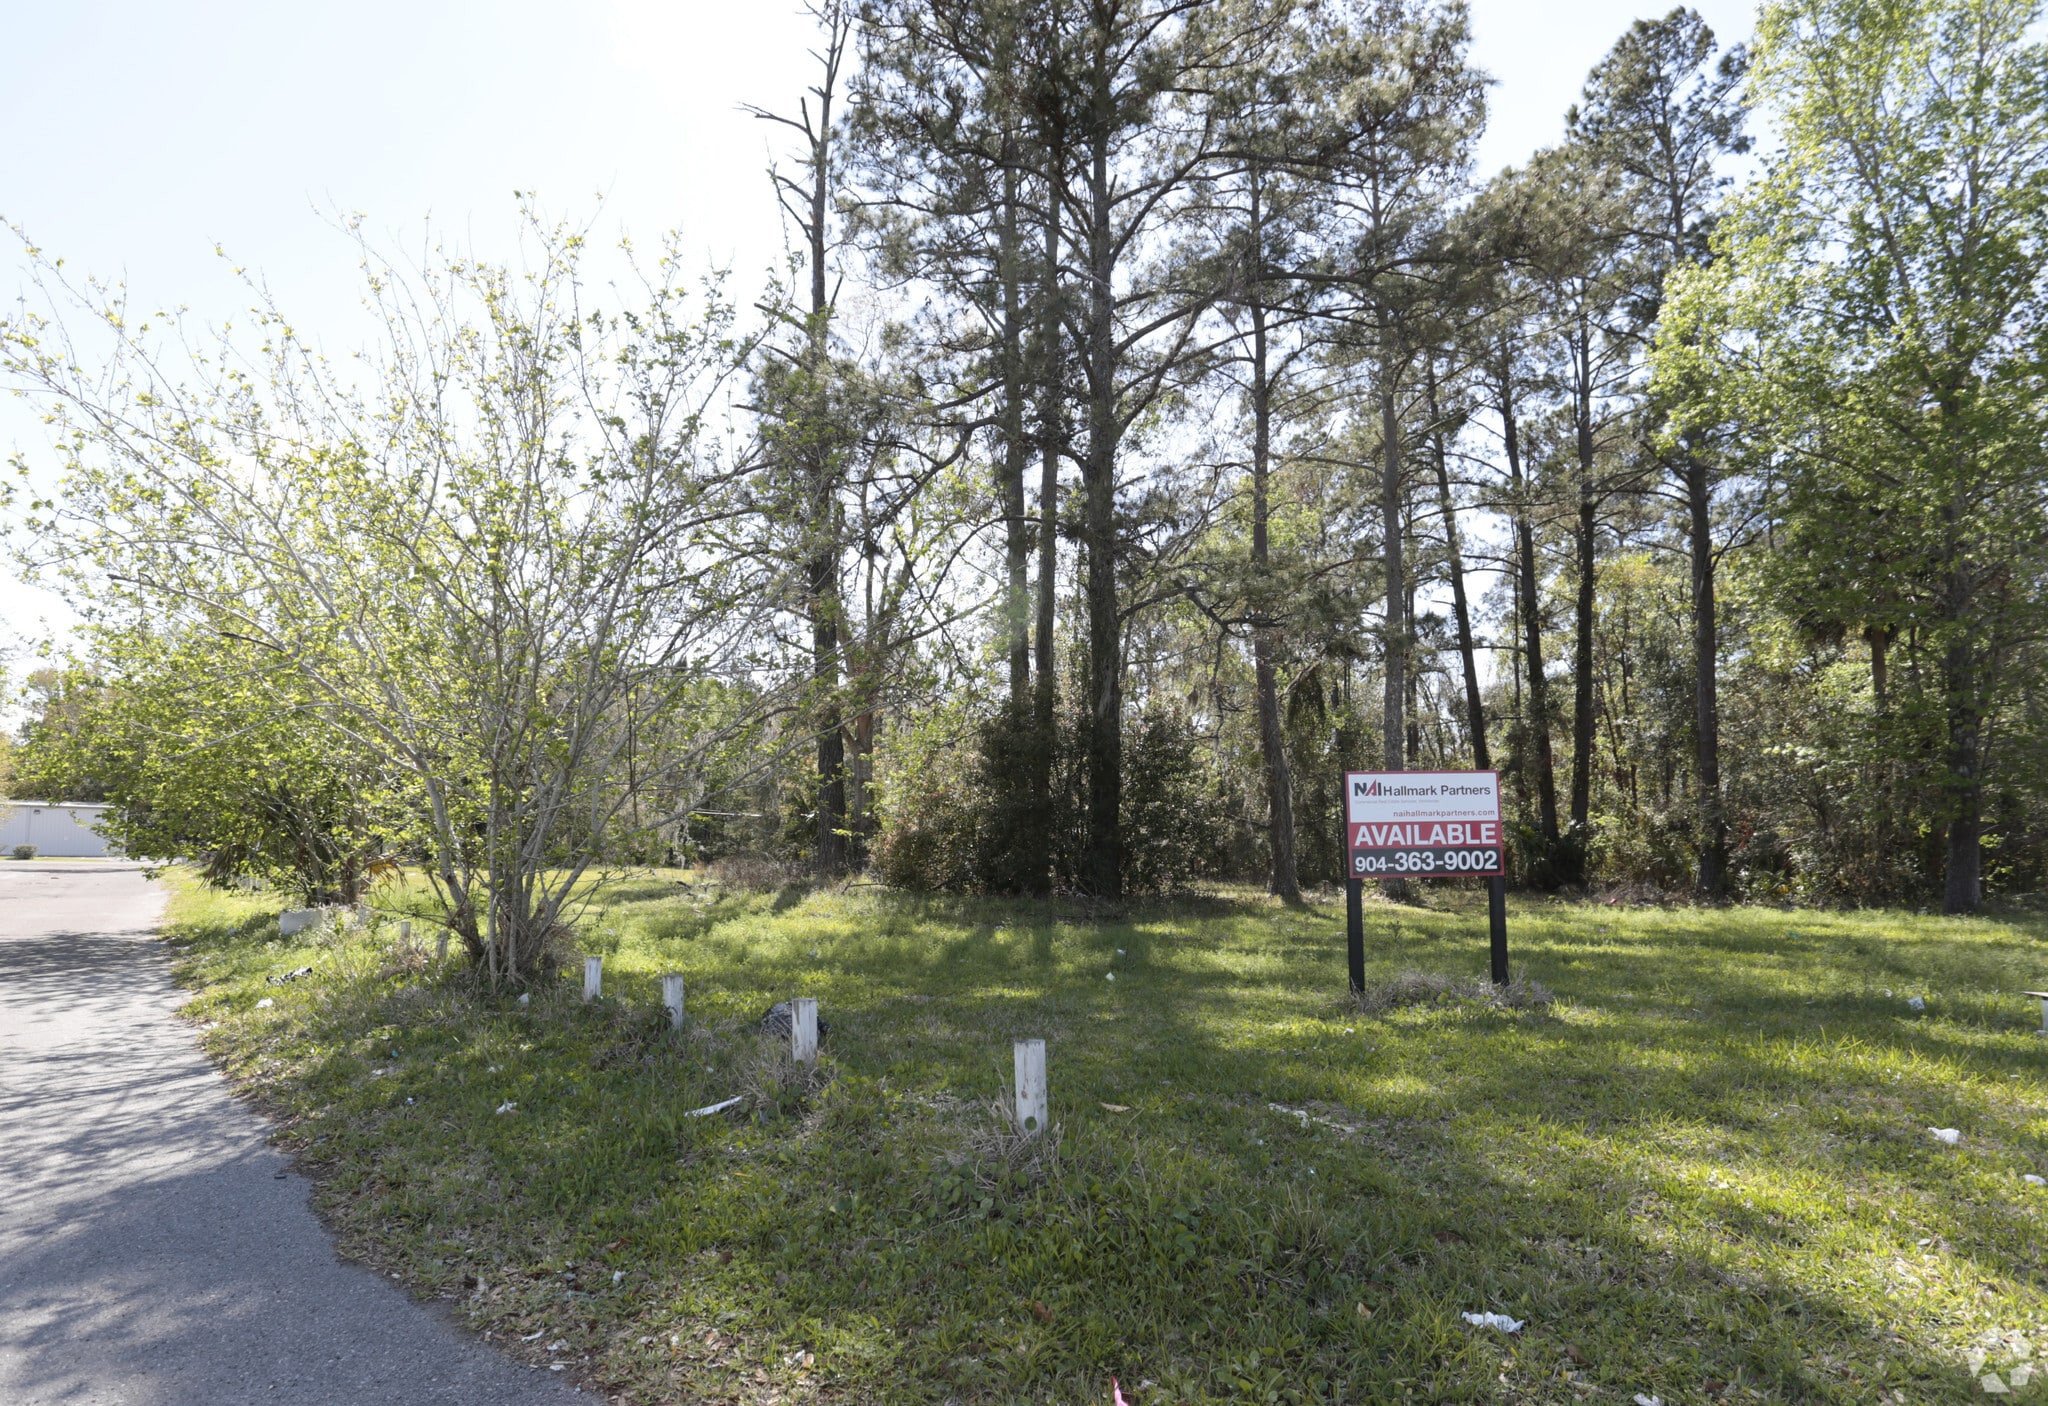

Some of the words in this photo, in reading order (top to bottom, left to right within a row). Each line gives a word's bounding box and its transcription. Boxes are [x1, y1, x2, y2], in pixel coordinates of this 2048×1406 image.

[1441, 785, 1491, 796] Partners
[1393, 809, 1496, 818] naihallmarkpartners.com
[1354, 823, 1497, 847] AVAILABLE
[1355, 850, 1498, 872] 904-363-9002
